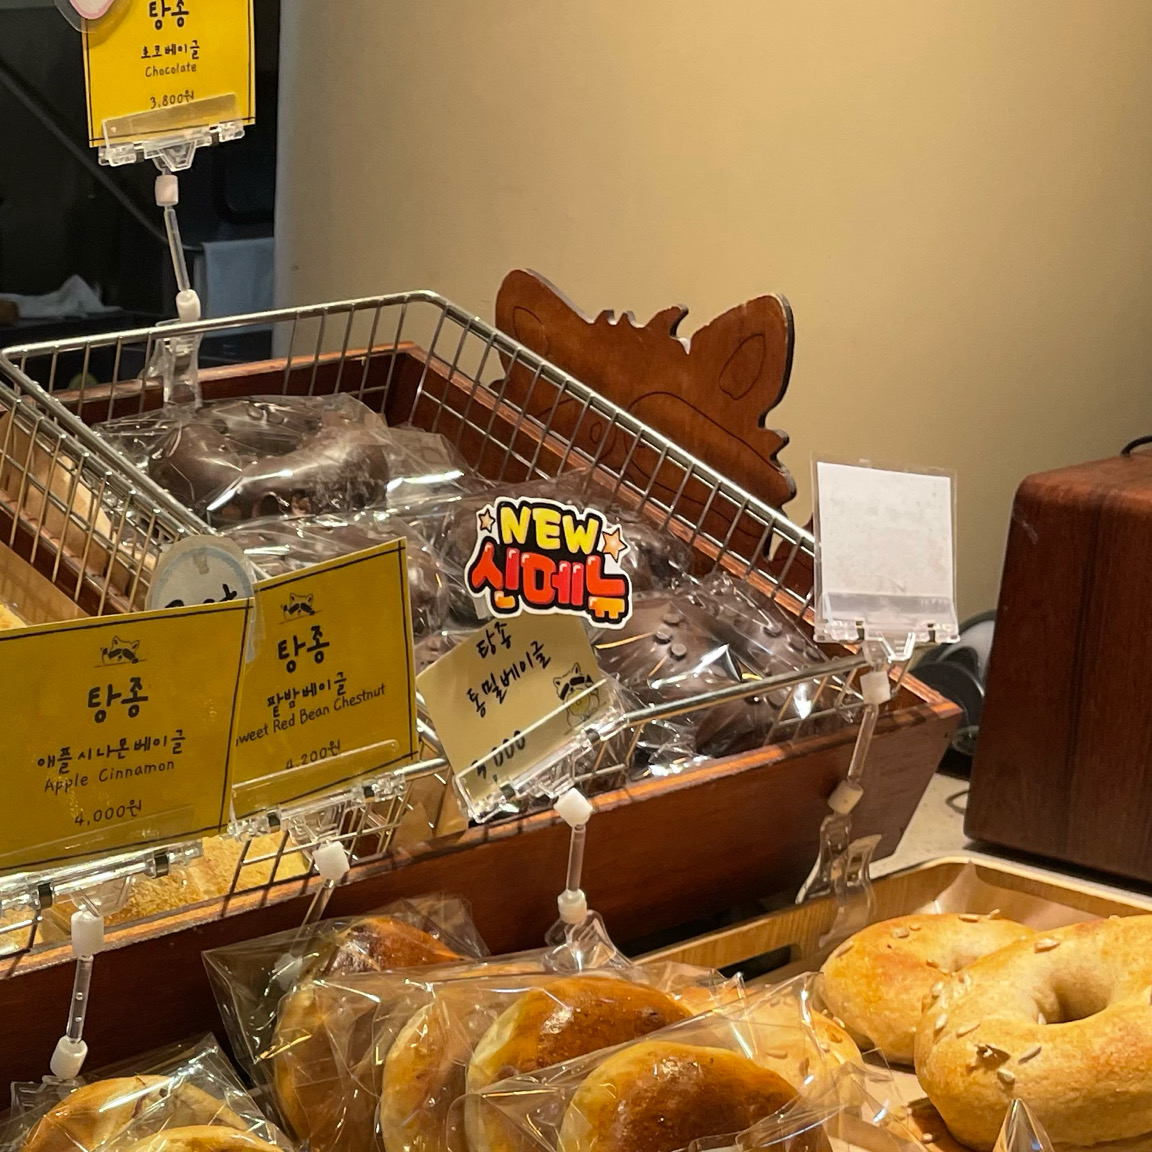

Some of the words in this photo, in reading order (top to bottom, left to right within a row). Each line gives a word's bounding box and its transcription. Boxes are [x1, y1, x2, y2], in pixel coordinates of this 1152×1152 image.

[141, 40, 200, 60] 초코베이글
[145, 62, 198, 78] Chocolate
[499, 504, 600, 556] NEW
[470, 541, 627, 620] 신메뉴
[277, 624, 330, 673] 탕종
[87, 676, 149, 723] 탕종
[235, 725, 269, 748] weet
[273, 710, 295, 732] Red
[300, 704, 329, 726] Bean
[333, 682, 386, 710] Chestnut
[266, 671, 347, 718] 팥밤베이글
[37, 728, 186, 774] 애플시나몬베이글
[44, 774, 88, 796] Apple
[98, 758, 175, 783] Cinnamon
